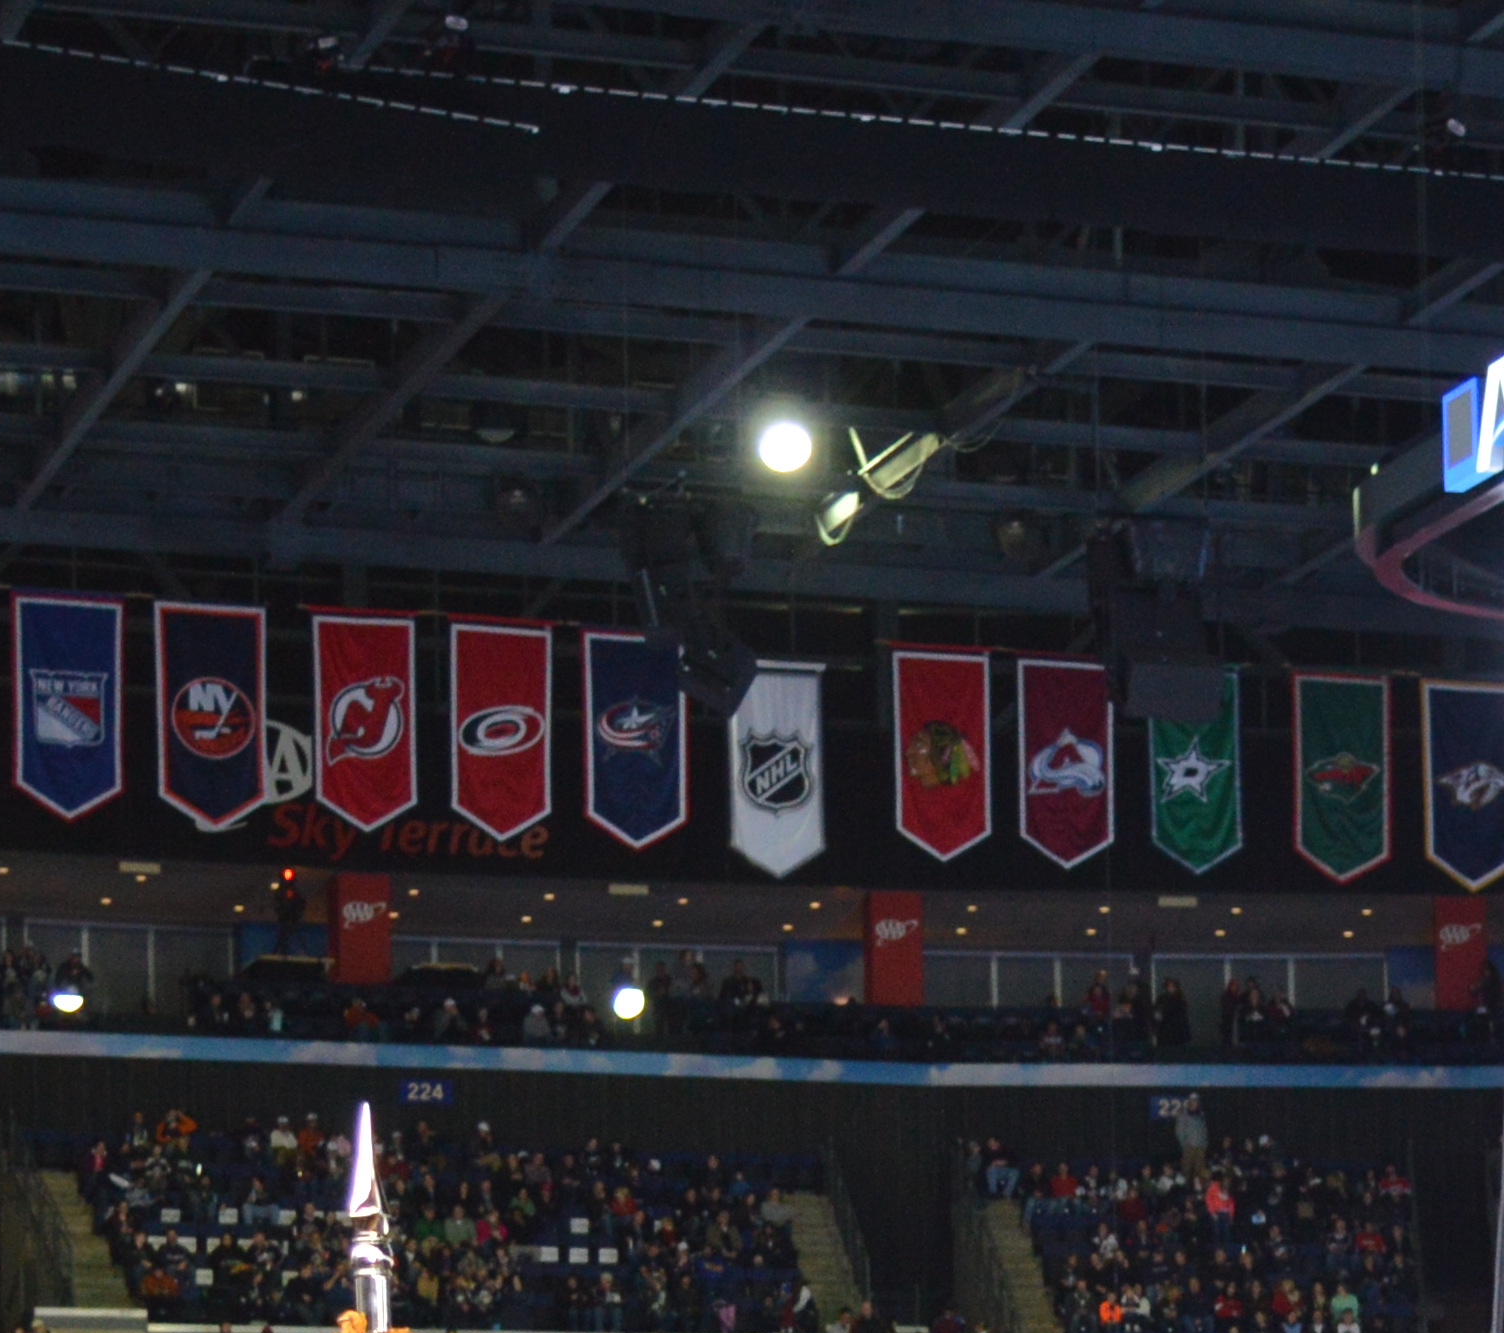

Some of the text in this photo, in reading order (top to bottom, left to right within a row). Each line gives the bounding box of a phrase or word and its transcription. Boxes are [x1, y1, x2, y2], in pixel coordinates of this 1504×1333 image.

[756, 754, 798, 794] NHL
[268, 803, 358, 862] Sky
[407, 1082, 444, 1101] 224
